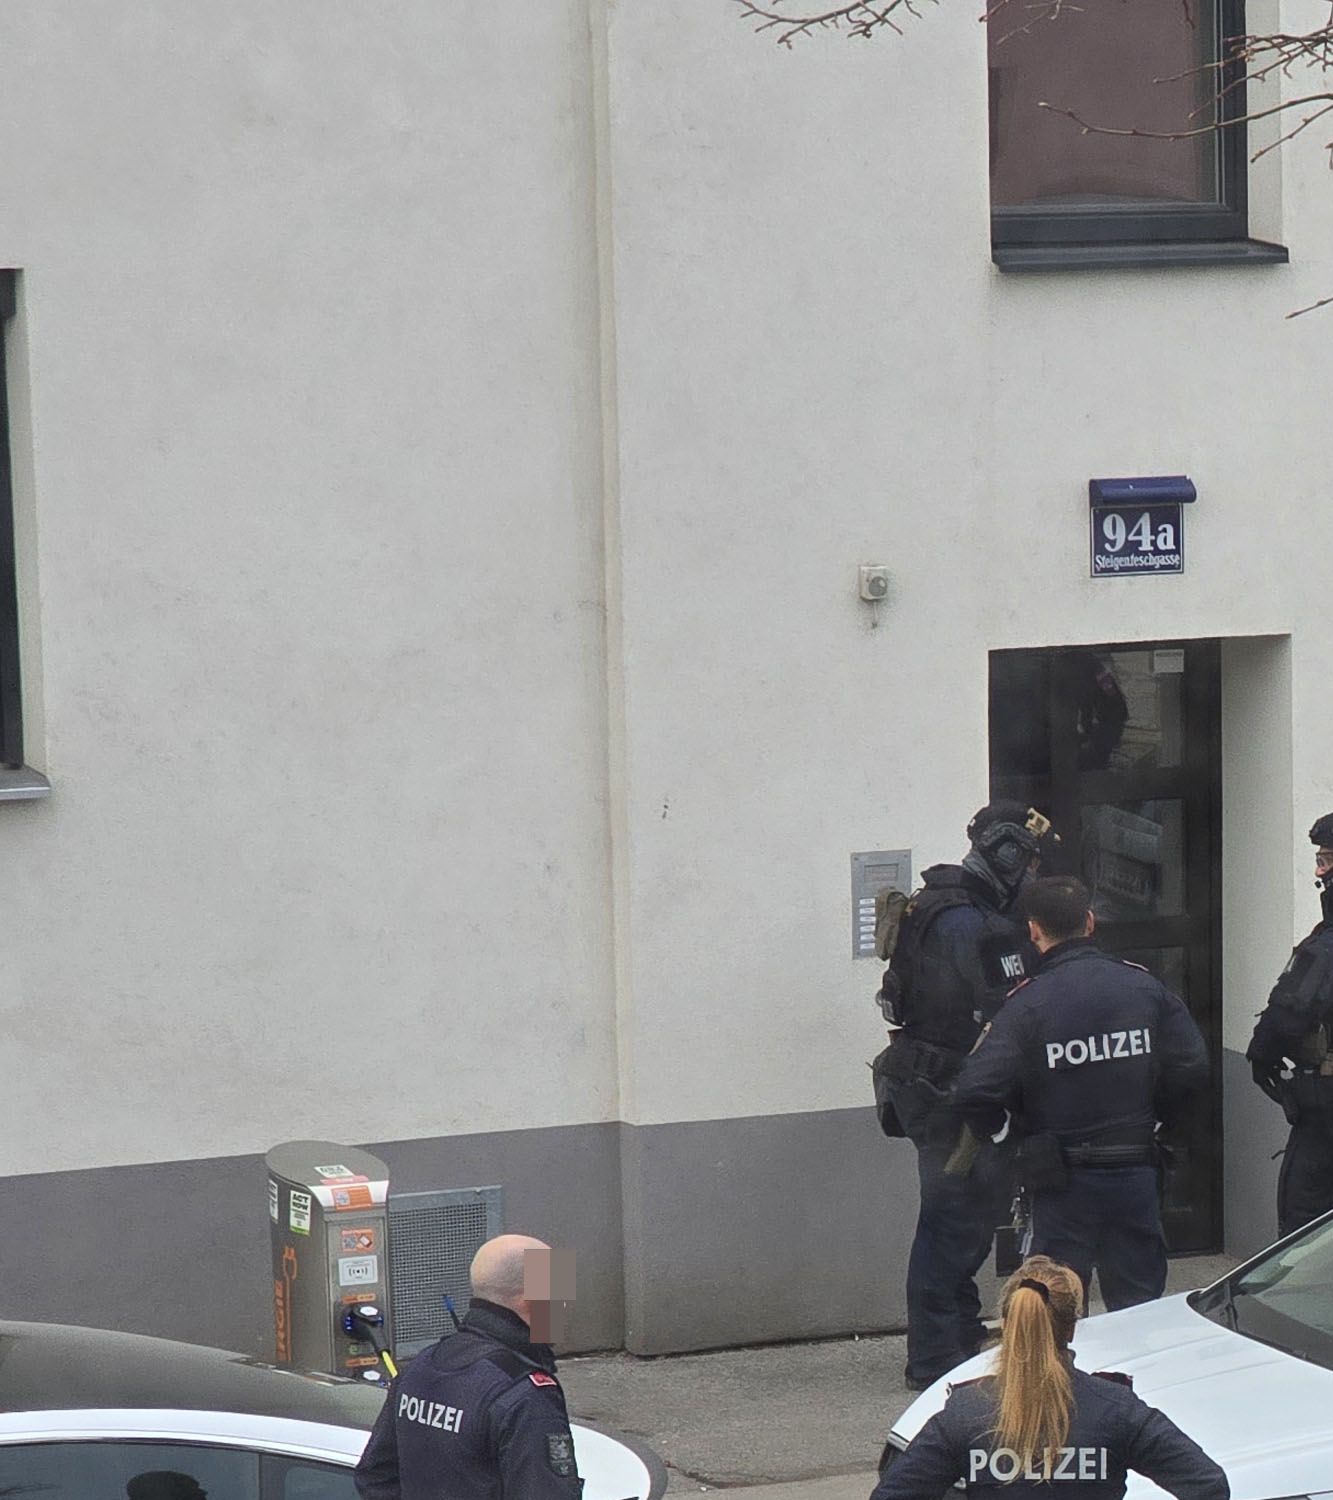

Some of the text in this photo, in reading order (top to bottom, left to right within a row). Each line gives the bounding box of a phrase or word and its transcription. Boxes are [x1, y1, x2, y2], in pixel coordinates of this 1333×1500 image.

[1103, 512, 1175, 552] 94a
[1046, 1028, 1151, 1068] POLIZEI
[399, 1393, 463, 1433] POLIZEI
[970, 1447, 1107, 1482] POLIZEI
